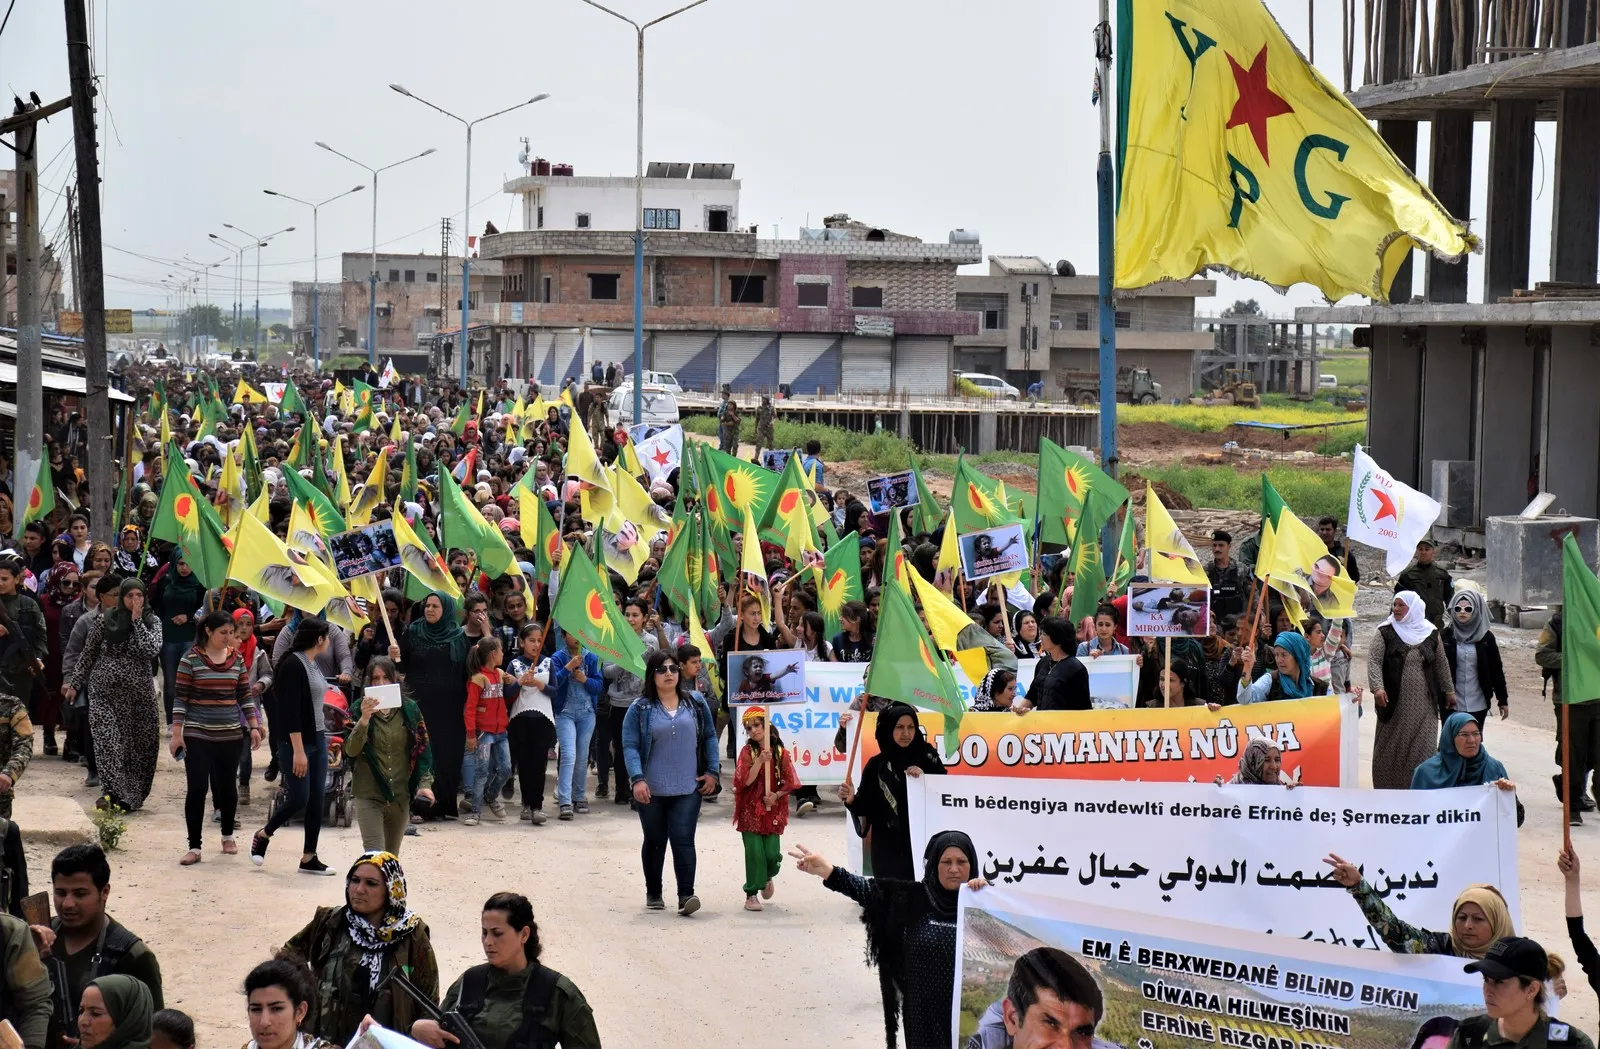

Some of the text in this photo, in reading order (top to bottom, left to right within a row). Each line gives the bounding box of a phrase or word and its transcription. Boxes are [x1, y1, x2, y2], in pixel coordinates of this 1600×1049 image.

[1378, 528, 1398, 539] 2003
[997, 729, 1184, 766] OSMANIYA
[1189, 718, 1239, 759] NÛ
[941, 794, 1481, 826] Em bêdengiya navdewltî derbarê Efrînê de; Şermezar dikin
[983, 844, 1070, 884] عفرين
[1079, 851, 1149, 889] حيال
[1159, 856, 1247, 902] الدولي
[1374, 860, 1439, 900] ندين
[1082, 938, 1112, 960] EM
[1118, 940, 1132, 963] Ê
[1137, 947, 1279, 987] BERXWEDANÊ
[1142, 979, 1221, 1013] DÎWARA
[1142, 1011, 1215, 1041] EFRÎNÊ
